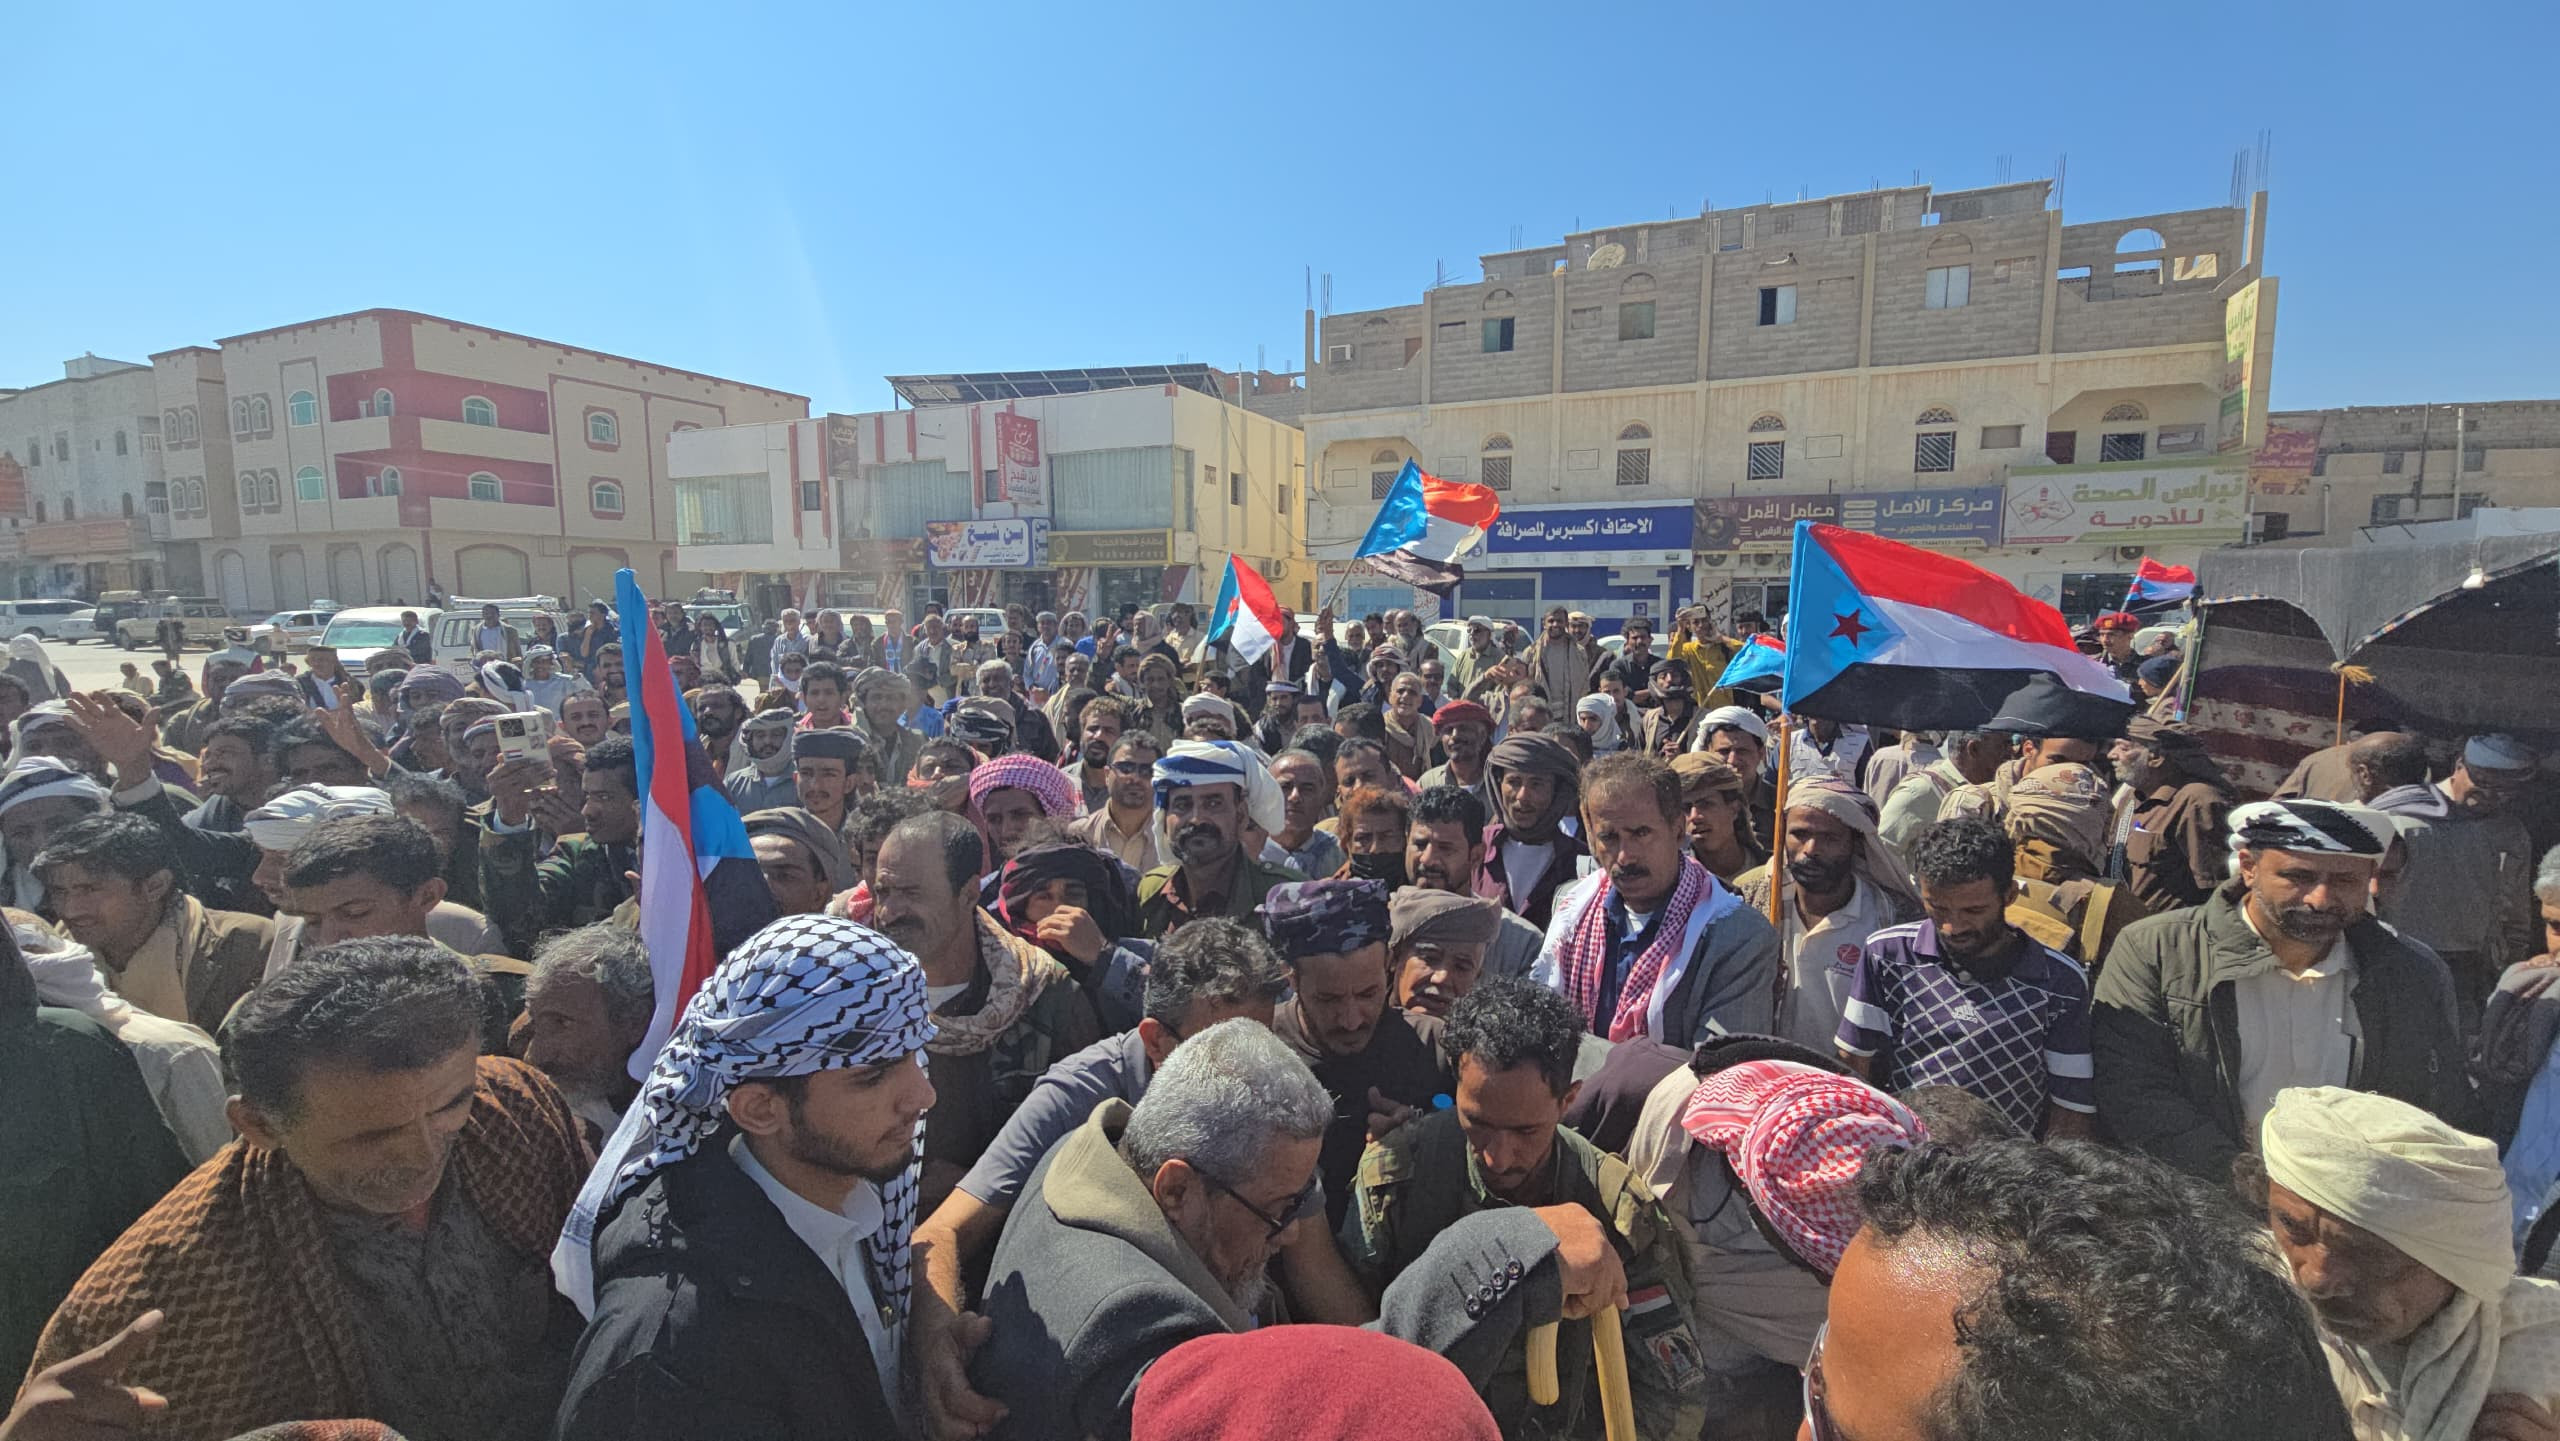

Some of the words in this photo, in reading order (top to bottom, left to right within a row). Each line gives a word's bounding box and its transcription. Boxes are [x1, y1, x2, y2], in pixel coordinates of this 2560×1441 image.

[2073, 477, 2157, 503] الصحة
[2161, 474, 2242, 503] نبراس
[1739, 500, 1780, 522] الأمل
[1783, 502, 1836, 521] معامل
[1882, 496, 1931, 517] الأمل
[1934, 497, 1994, 517] مركز
[1601, 517, 1654, 535] الاحقاف
[2089, 507, 2205, 529] للأدوية
[967, 522, 1000, 546] شيخ
[1003, 527, 1024, 546] بن
[1495, 520, 1545, 541] للصرافة
[1545, 518, 1599, 541] اكسبرس
